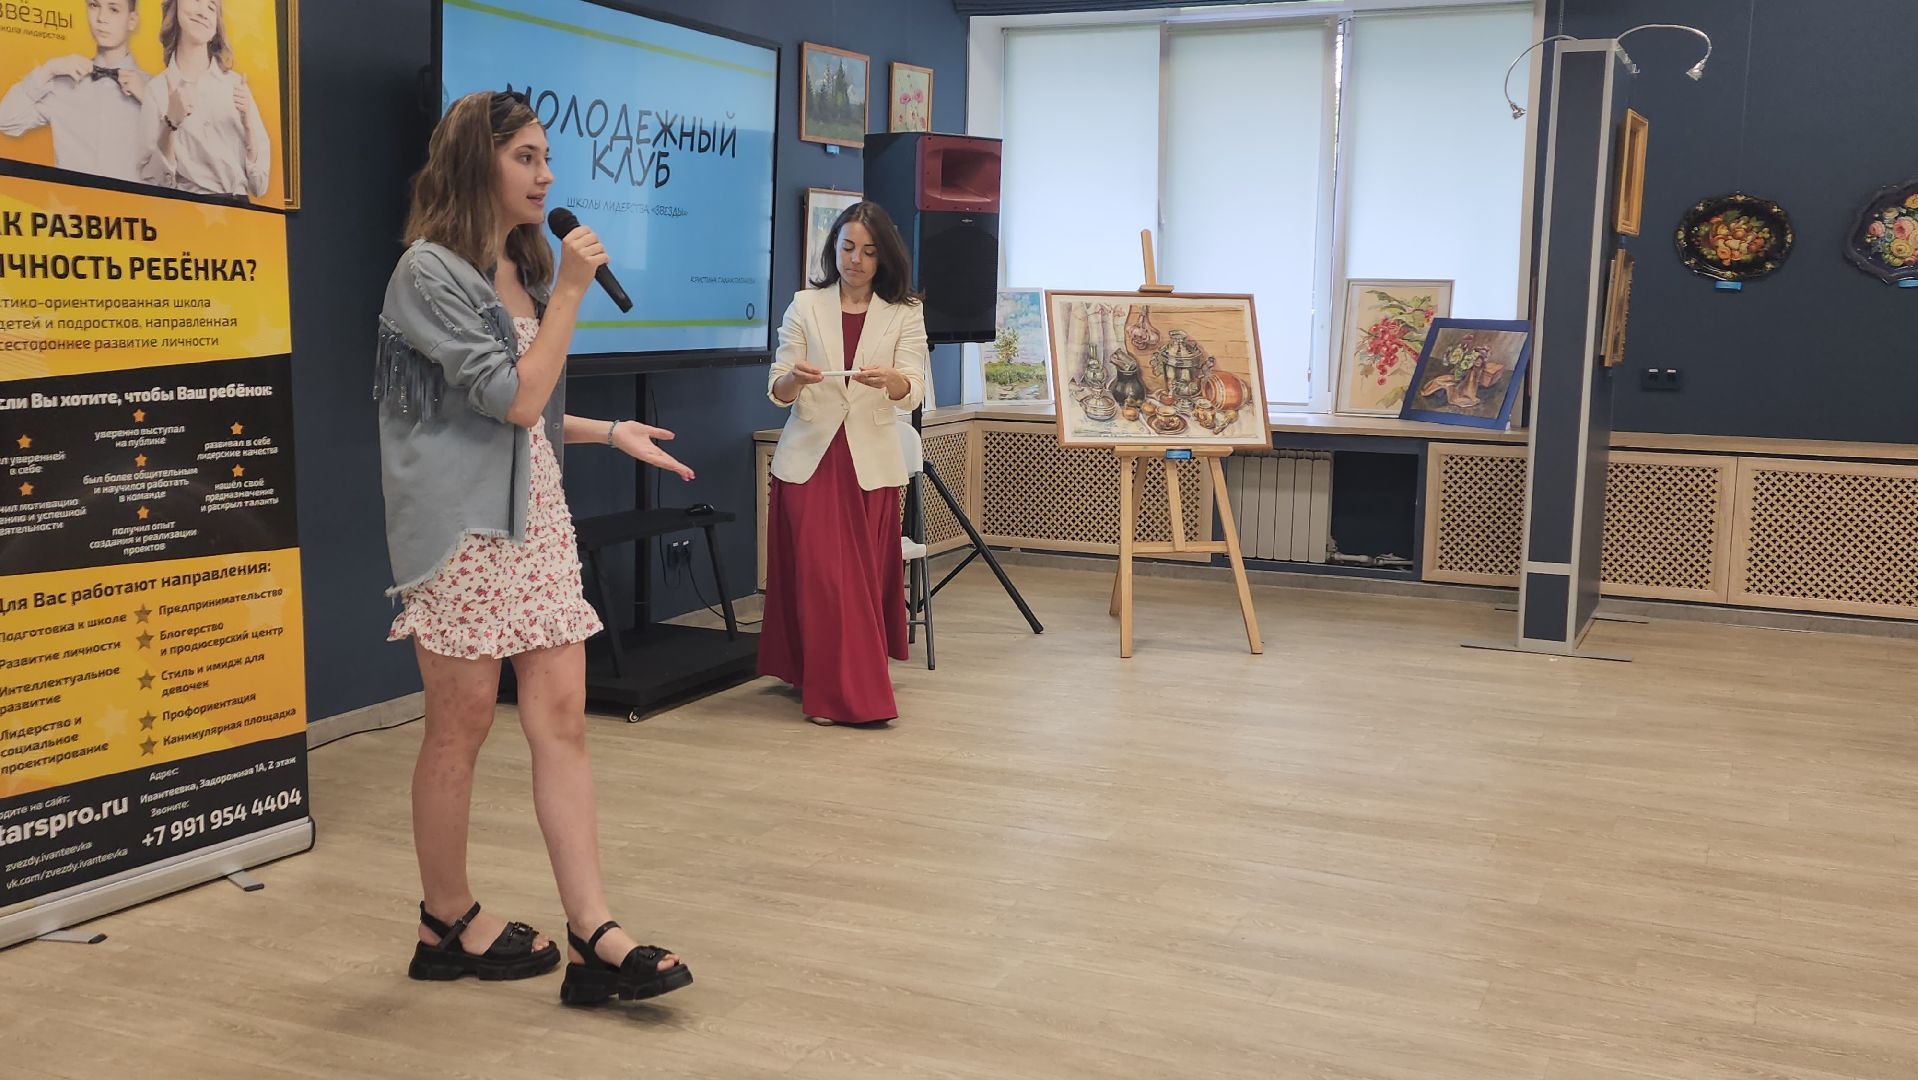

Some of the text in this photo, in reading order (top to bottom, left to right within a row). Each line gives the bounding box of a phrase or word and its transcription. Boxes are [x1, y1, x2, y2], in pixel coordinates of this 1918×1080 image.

[0, 0, 72, 29] вёзды
[507, 83, 737, 158] ОЛОДЕЖНЫЙ
[592, 140, 671, 188] КЛУБ
[567, 197, 600, 209] ШКОЛЫ
[0, 210, 157, 242] К РАЗВИТЬ
[129, 251, 257, 281] РЕБЁНКА?
[0, 298, 211, 311] тико-ориентированная школа
[46, 320, 53, 329] и
[145, 318, 237, 330] направленная
[95, 338, 157, 352] развитие
[162, 337, 218, 347] личности
[31, 393, 58, 408] Вы
[61, 393, 122, 406] хотите,
[124, 387, 174, 402] чтобы
[177, 386, 207, 400] Ваш
[209, 384, 273, 401] ребёнок:
[94, 425, 185, 441] уверенно выступал
[128, 436, 166, 448] публике
[205, 440, 244, 451] развивал
[253, 436, 271, 446] себе
[10, 451, 66, 466] уверенней
[197, 447, 278, 460] лидерские качества
[18, 464, 43, 475] себе
[83, 467, 198, 485] был более общительным
[94, 478, 190, 495] и научился работать
[215, 481, 242, 490] нашёл
[20, 498, 79, 511] мотивацию
[126, 491, 166, 501] команде
[205, 488, 275, 503] предназначение
[201, 497, 279, 513] и раскрыл таланты
[37, 506, 87, 523] успешной
[112, 521, 176, 536] получил опыт
[88, 537, 134, 549] создания
[143, 529, 198, 544] реализации
[123, 542, 166, 556] проектов
[34, 591, 67, 608] Вас
[72, 578, 157, 606] работают
[161, 562, 271, 587] направления:
[159, 588, 283, 616] Предпринимательство
[78, 621, 85, 629] к
[88, 614, 127, 628] школе
[160, 622, 224, 641] Блогерство
[63, 641, 121, 659] личности
[160, 627, 284, 656] и продюсерский центр
[161, 653, 265, 681] Стиль и имидж для
[0, 666, 121, 698] Интеллектуальное
[162, 680, 209, 698] девочек
[0, 695, 61, 716] развитие
[162, 693, 256, 721] Профориентация
[0, 717, 82, 741] Лидерство и
[163, 707, 297, 746] Каникулярная площадка
[0, 733, 79, 758] социальное
[0, 742, 109, 776] проектирование
[140, 783, 199, 804] Ивантеевка,
[200, 766, 254, 788] Задорожная
[268, 760, 275, 770] 2
[275, 756, 297, 768] этаж
[30, 802, 44, 811] на
[141, 787, 302, 847] +7 991 954 4404
[5, 841, 93, 872] zvezdy.ivanteevka
[6, 848, 129, 890] vk.com/zvezdy.ivanteevka
